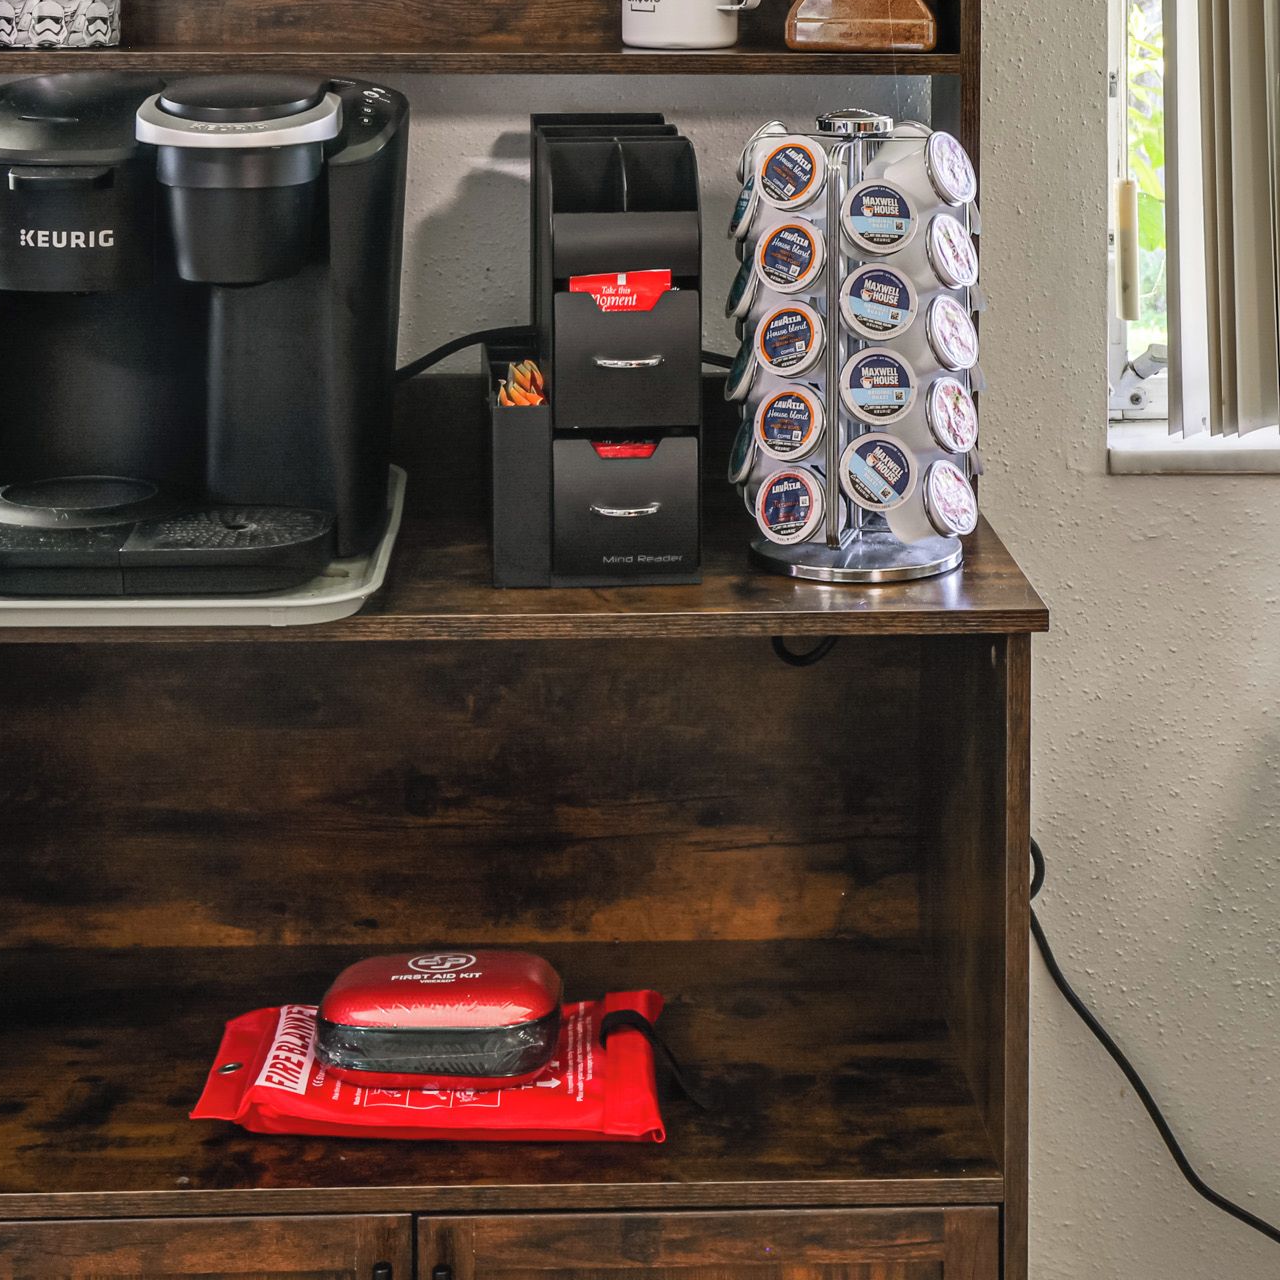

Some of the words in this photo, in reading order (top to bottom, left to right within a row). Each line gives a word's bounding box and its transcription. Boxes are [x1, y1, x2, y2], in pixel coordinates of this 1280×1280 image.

[775, 152, 794, 169] House
[792, 164, 811, 182] blend
[862, 196, 899, 206] MAXWELL
[874, 205, 900, 215] HOUSE
[19, 228, 114, 249] KEURIG
[771, 237, 791, 250] House
[791, 244, 811, 258] blend
[601, 285, 617, 294] Take
[618, 285, 631, 294] this
[864, 279, 900, 296] MAXWELL
[872, 291, 900, 305] HOUSE
[766, 329, 788, 340] House
[788, 321, 808, 333] blend
[861, 367, 899, 376] MAXWELL
[873, 375, 899, 384] HOUSE
[767, 409, 788, 419] House
[789, 410, 809, 420] blend
[873, 446, 904, 478] MAXWELL
[875, 461, 899, 485] HOUSE
[602, 555, 634, 564] Mind
[637, 554, 683, 563] Reader
[264, 1054, 306, 1091] FIRE
